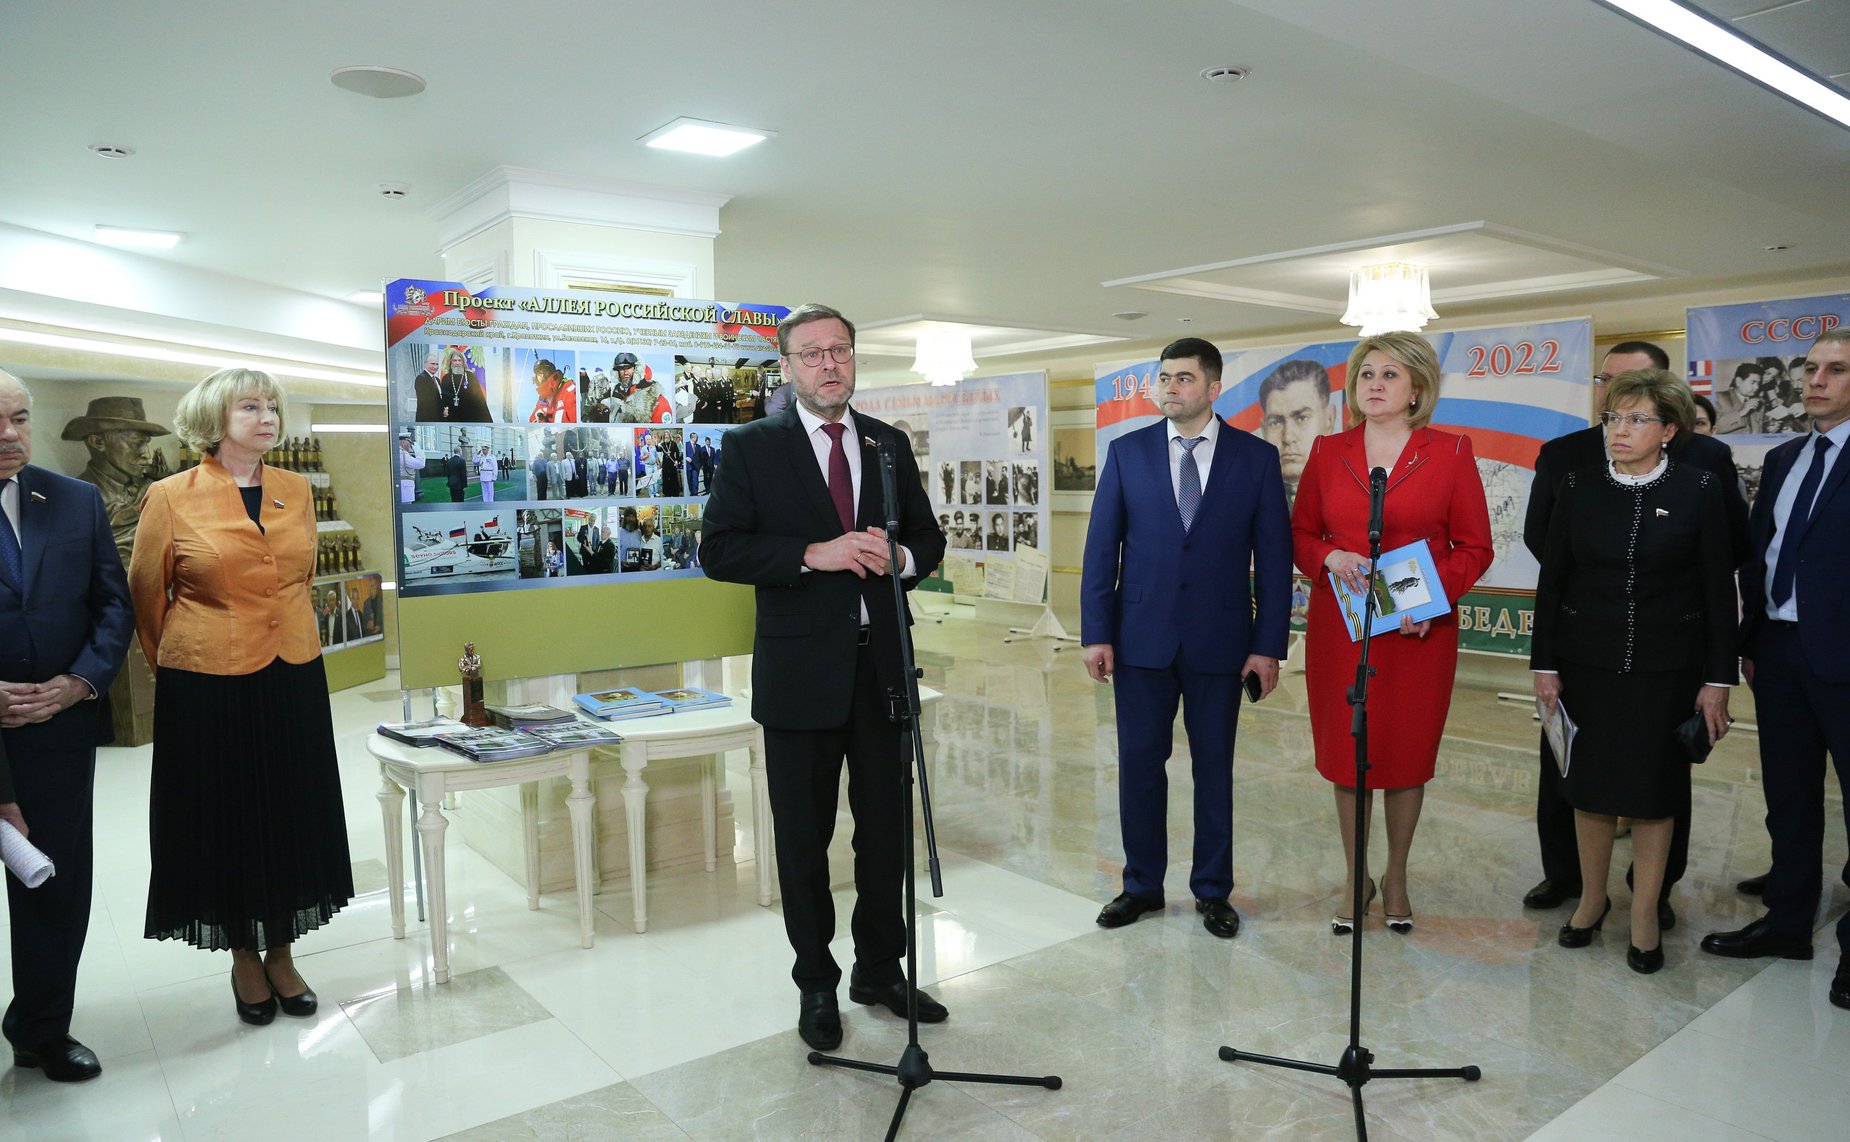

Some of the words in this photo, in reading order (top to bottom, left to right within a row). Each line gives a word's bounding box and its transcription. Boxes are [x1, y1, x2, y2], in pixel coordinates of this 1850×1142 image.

[442, 289, 515, 312] Проект
[518, 295, 592, 316] «АЛЛЕЯ
[593, 299, 718, 324] РОССИЙСКОЙ
[456, 318, 488, 328] БЮСТЫ
[757, 335, 779, 344] ЧАСТЯ
[1740, 314, 1840, 344] СССР
[1467, 339, 1562, 378] 2022
[1112, 373, 1160, 402] 194
